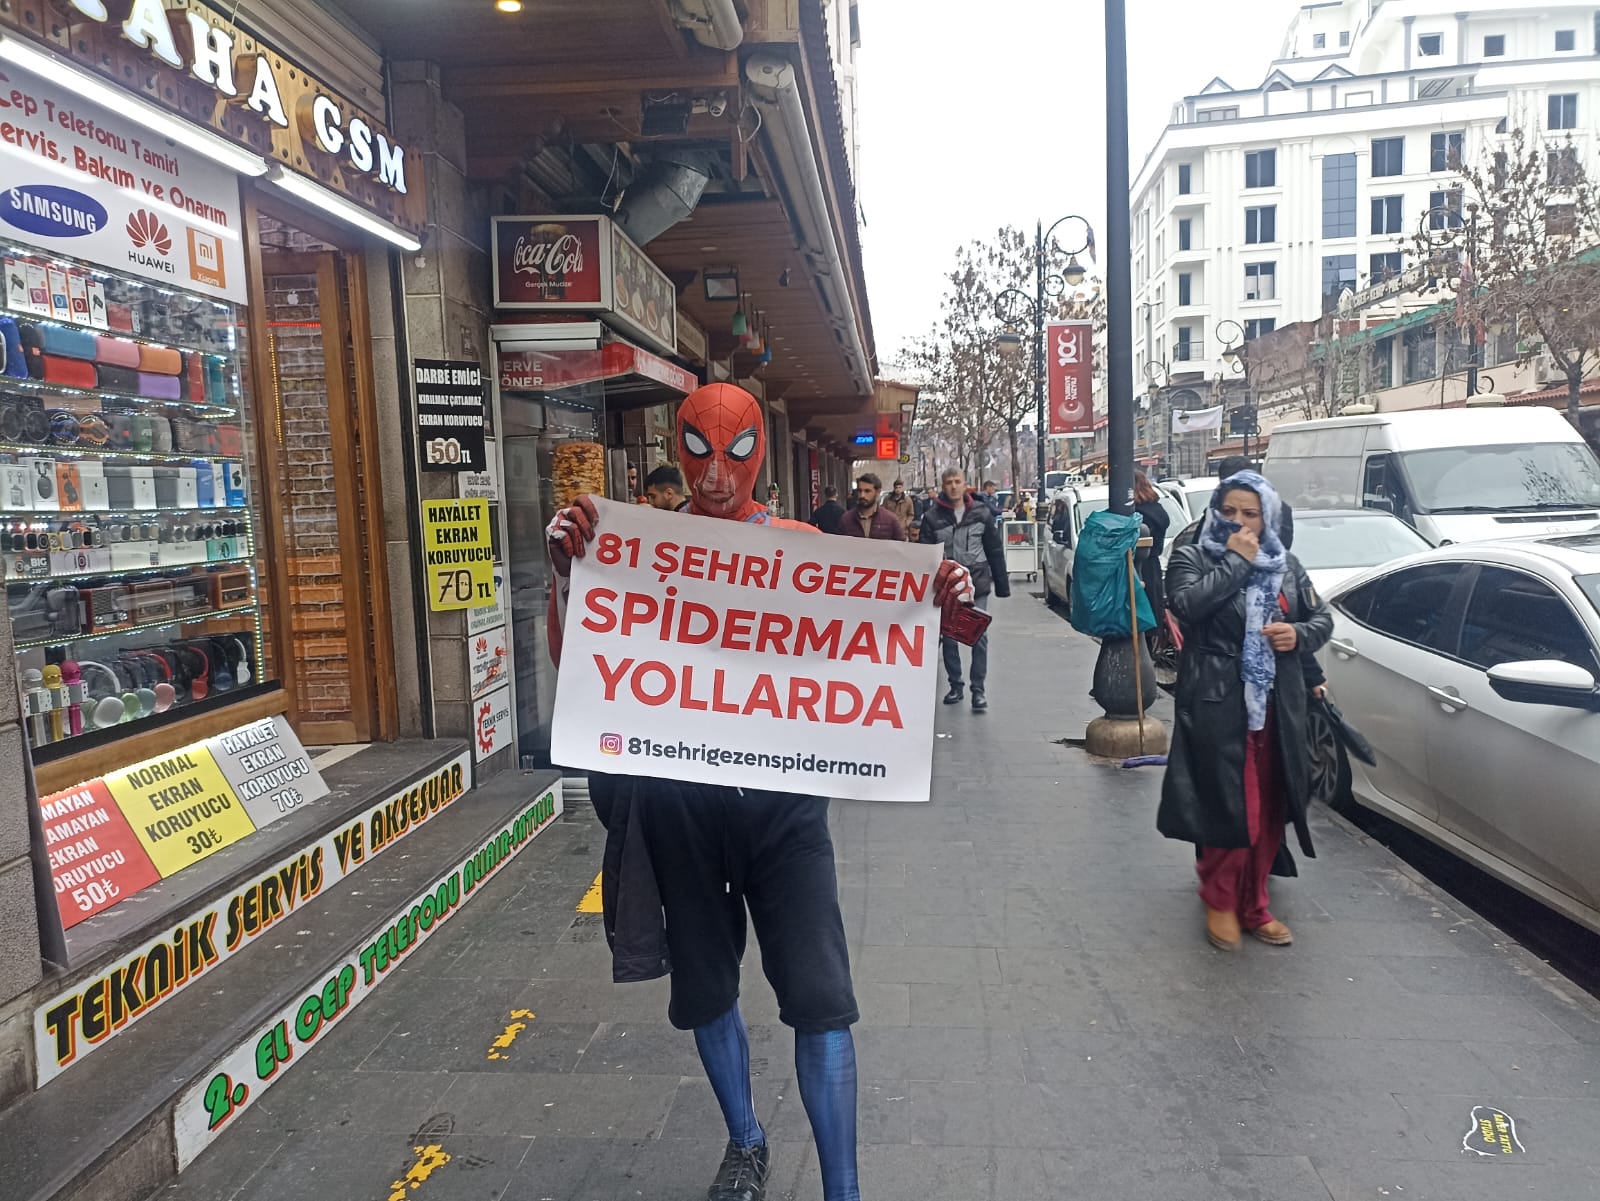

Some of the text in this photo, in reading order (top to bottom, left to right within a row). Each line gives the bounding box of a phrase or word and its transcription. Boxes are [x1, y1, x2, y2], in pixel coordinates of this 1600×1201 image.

[70, 0, 408, 195] AHA GSM
[43, 99, 128, 154] Telefonu
[131, 139, 180, 177] Tamiri
[73, 145, 136, 190] Bakım
[141, 178, 165, 202] ve
[169, 186, 229, 227] Onarım
[9, 187, 97, 233] SAMSUNG
[128, 250, 175, 274] HUAWEI
[513, 234, 584, 275] Coca-Cola
[416, 367, 450, 384] DARBE
[418, 394, 482, 407] KIRILMAZ ÇATLAMAZ
[419, 414, 483, 426] EKRAN KORUYUCU
[430, 439, 472, 464] 50 TL
[881, 441, 894, 456] E
[428, 505, 481, 522] HAYALET
[436, 526, 478, 544] EKRAN
[427, 547, 491, 565] KORUYUCU
[594, 532, 930, 603] 81 ŞEHRİ GEZEN
[437, 569, 491, 602] 70 TL
[580, 585, 925, 668] SPİDERMAN
[592, 653, 905, 730] YOLLARDA
[220, 721, 279, 755] HAYALET
[126, 753, 198, 790] NORMAL
[239, 743, 287, 774] EKRAN
[627, 736, 887, 779] 81sehrigezenspiderman
[148, 777, 204, 811] EKRAN
[238, 757, 310, 801] KORUYUCU
[46, 807, 111, 846] AMAYAN
[145, 793, 231, 843] KORUYUCU
[333, 820, 365, 875] VE
[370, 762, 464, 855] AKSESUAR
[203, 1072, 250, 1132] 2.
[255, 1018, 294, 1082] EL
[295, 963, 358, 1044] CEP
[359, 870, 460, 988] TELEFONU
[1480, 1118, 1497, 1144] STUDIO
